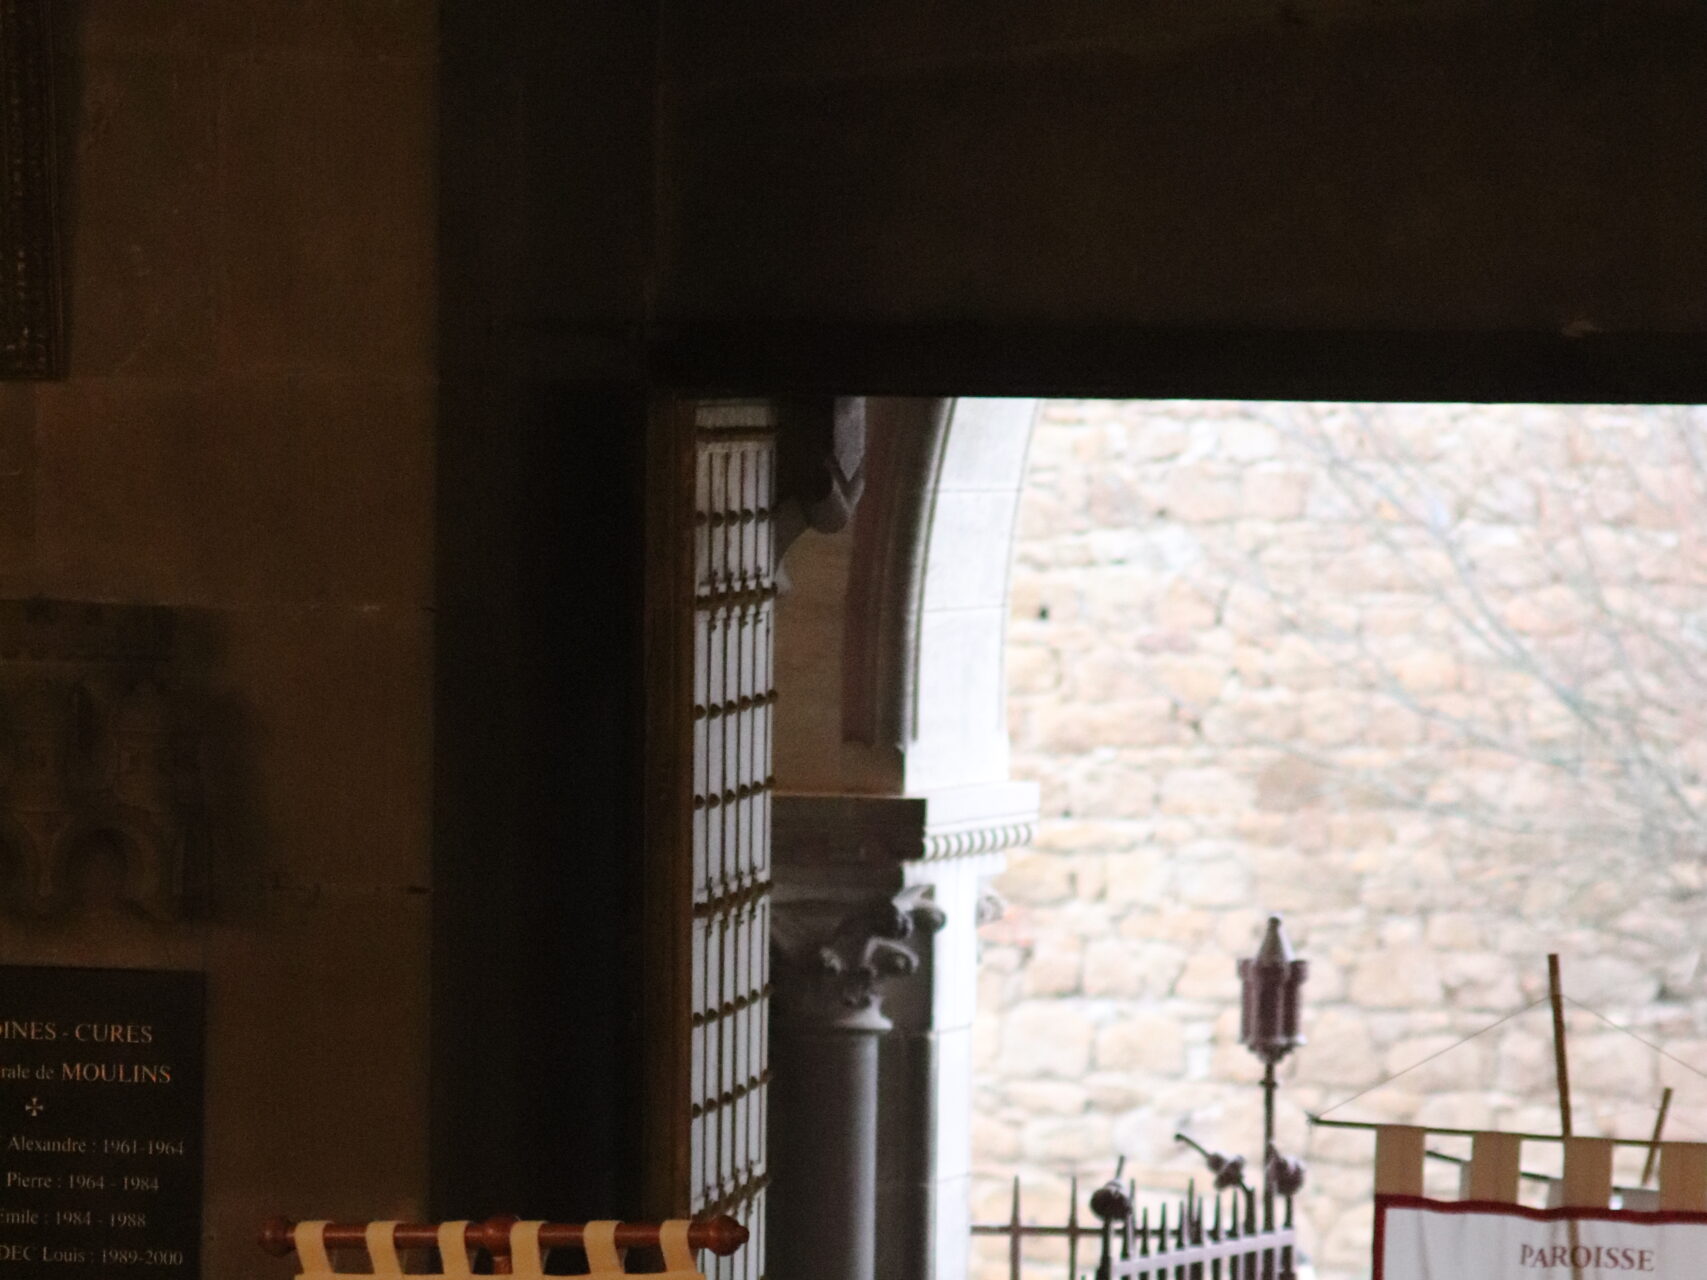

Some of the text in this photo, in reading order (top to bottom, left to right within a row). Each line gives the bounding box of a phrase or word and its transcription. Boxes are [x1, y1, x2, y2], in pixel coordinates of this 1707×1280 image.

[0, 1020, 57, 1040] INES
[35, 1063, 54, 1080] de
[62, 1062, 172, 1084] MOULINS
[7, 1171, 52, 1189] Pierre
[1519, 1244, 1655, 1272] PAROISSE
